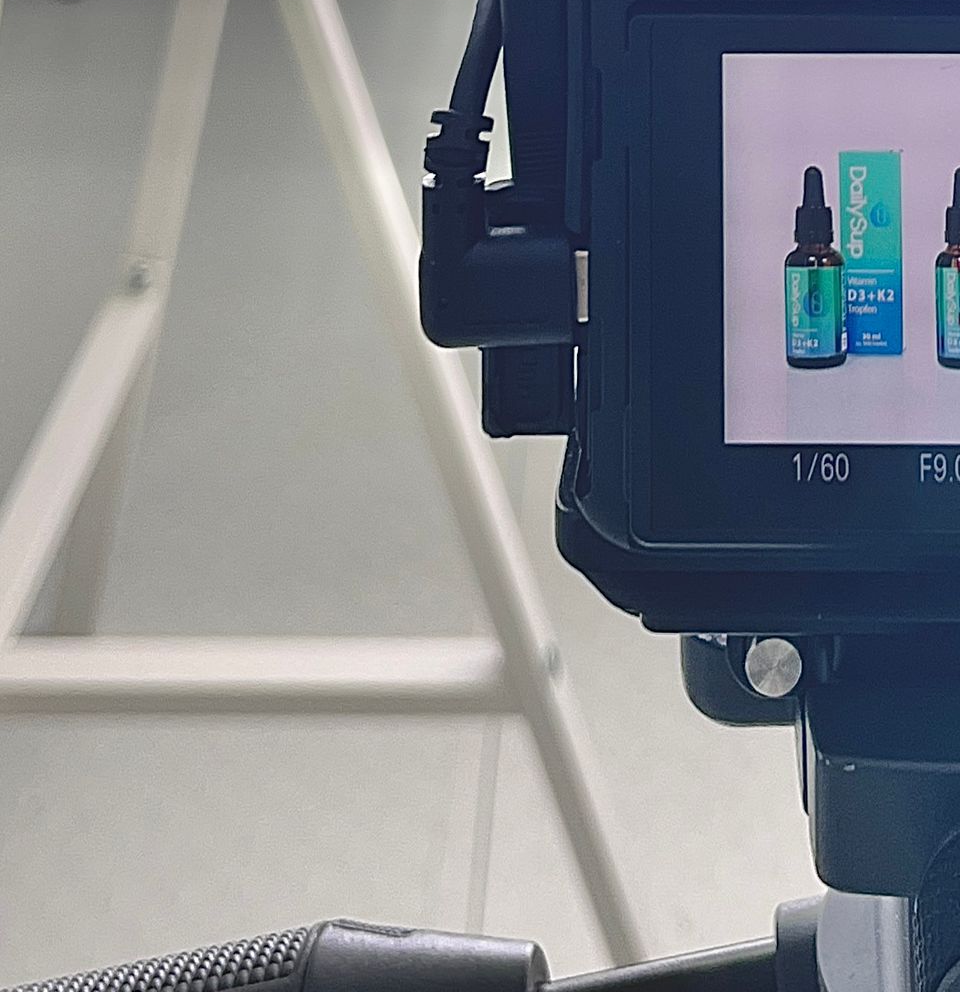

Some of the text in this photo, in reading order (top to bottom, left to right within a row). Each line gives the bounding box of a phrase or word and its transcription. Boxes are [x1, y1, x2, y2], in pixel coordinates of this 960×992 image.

[847, 166, 867, 258] DailySup
[848, 276, 878, 286] Vitamin
[847, 289, 895, 302] D3+K2
[792, 453, 849, 482] 1/60
